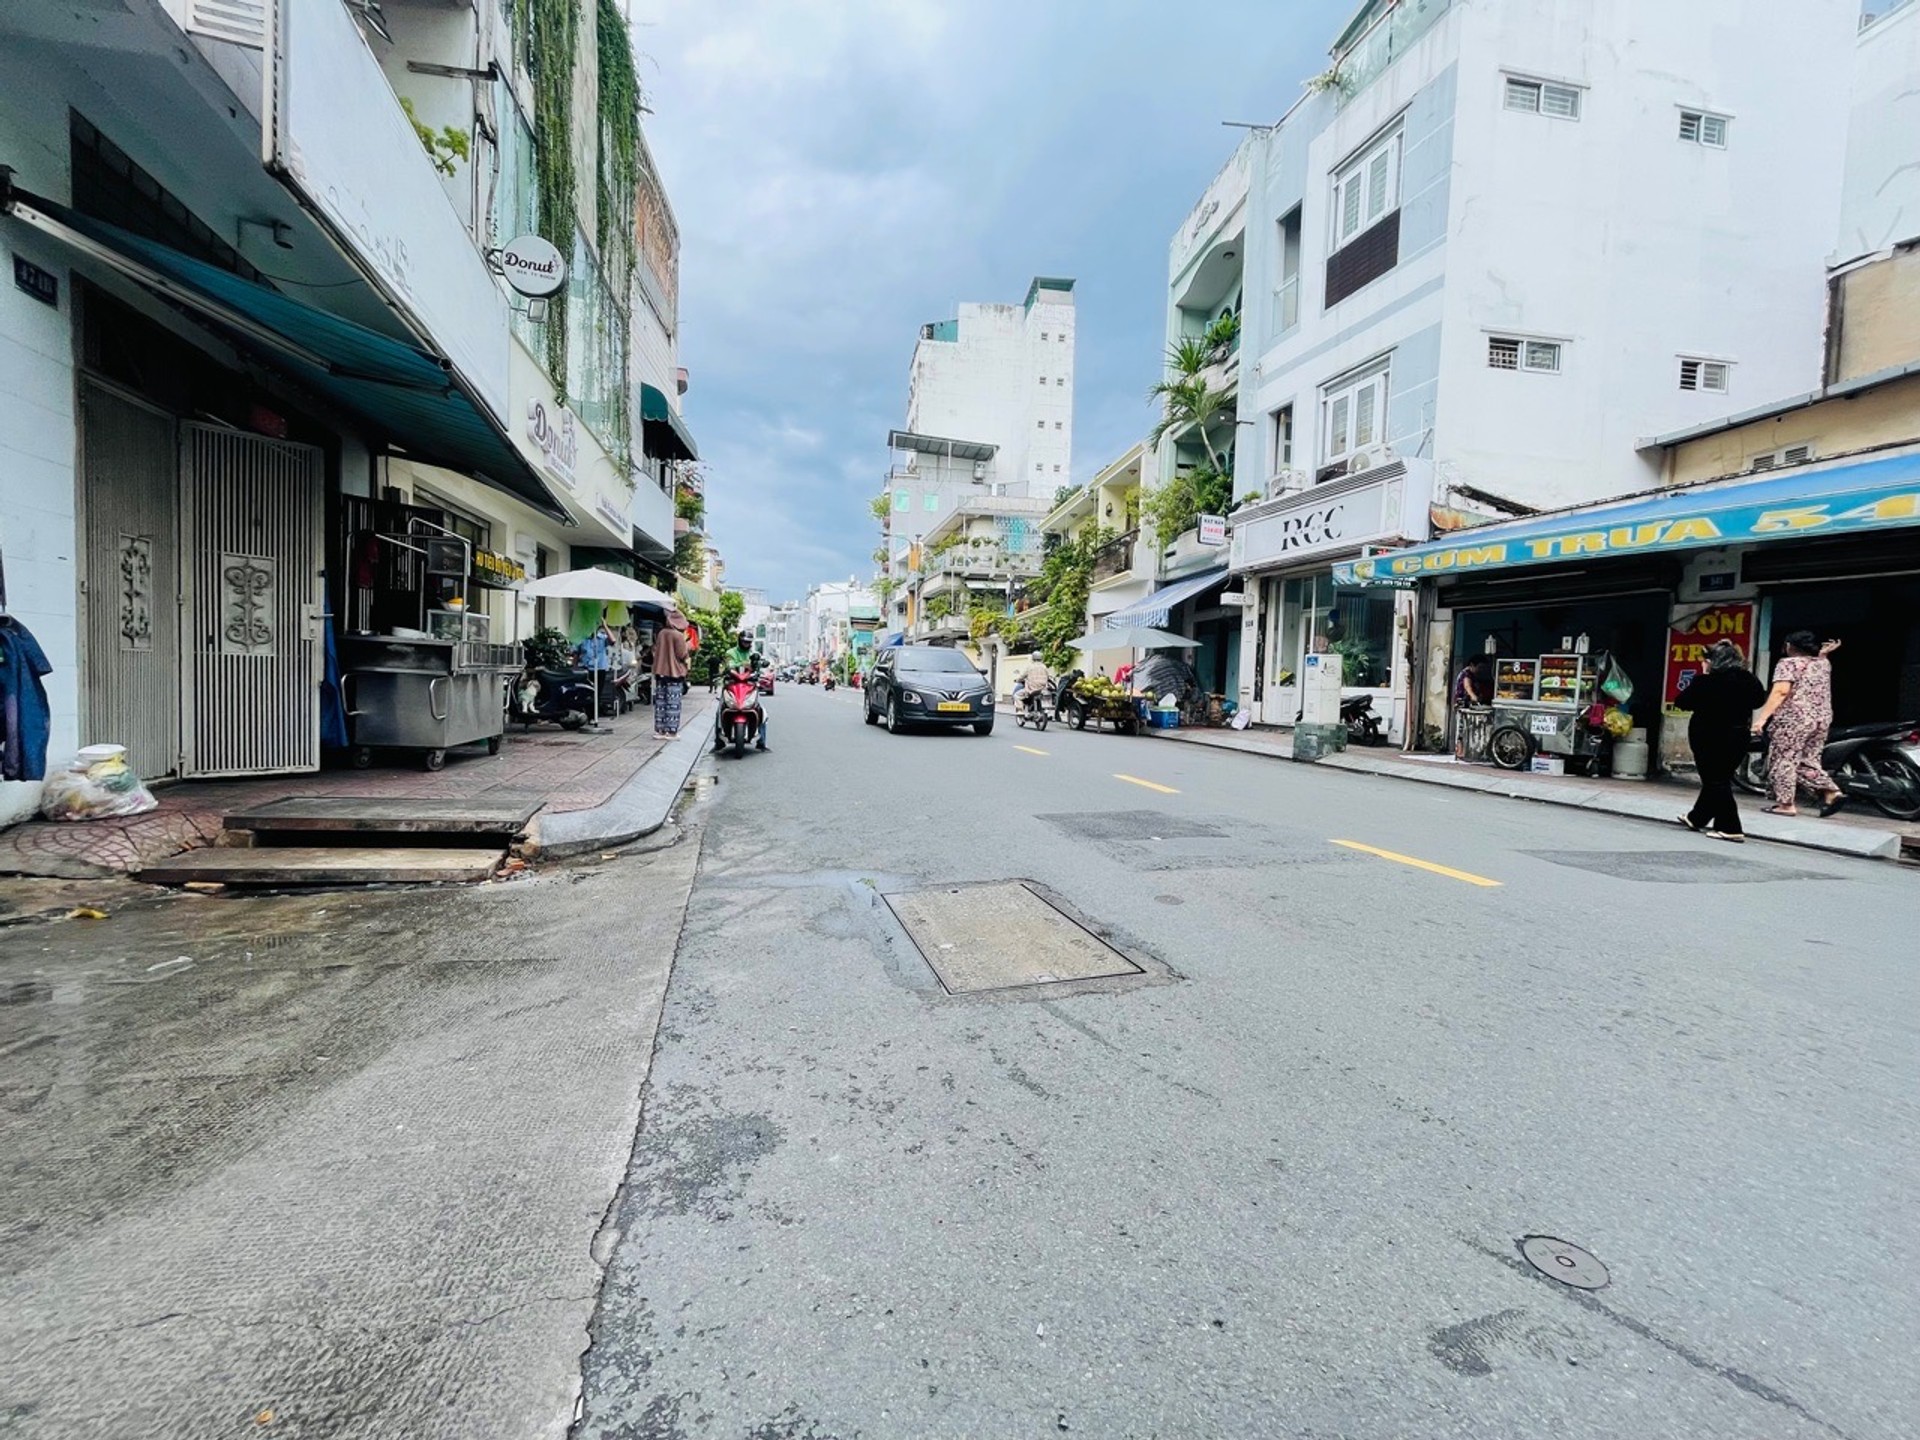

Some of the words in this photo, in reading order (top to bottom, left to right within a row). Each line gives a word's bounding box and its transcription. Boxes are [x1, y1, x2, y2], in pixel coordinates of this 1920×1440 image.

[504, 251, 554, 274] Donut
[1280, 505, 1344, 551] RCC
[1525, 517, 1722, 558] TRƯA
